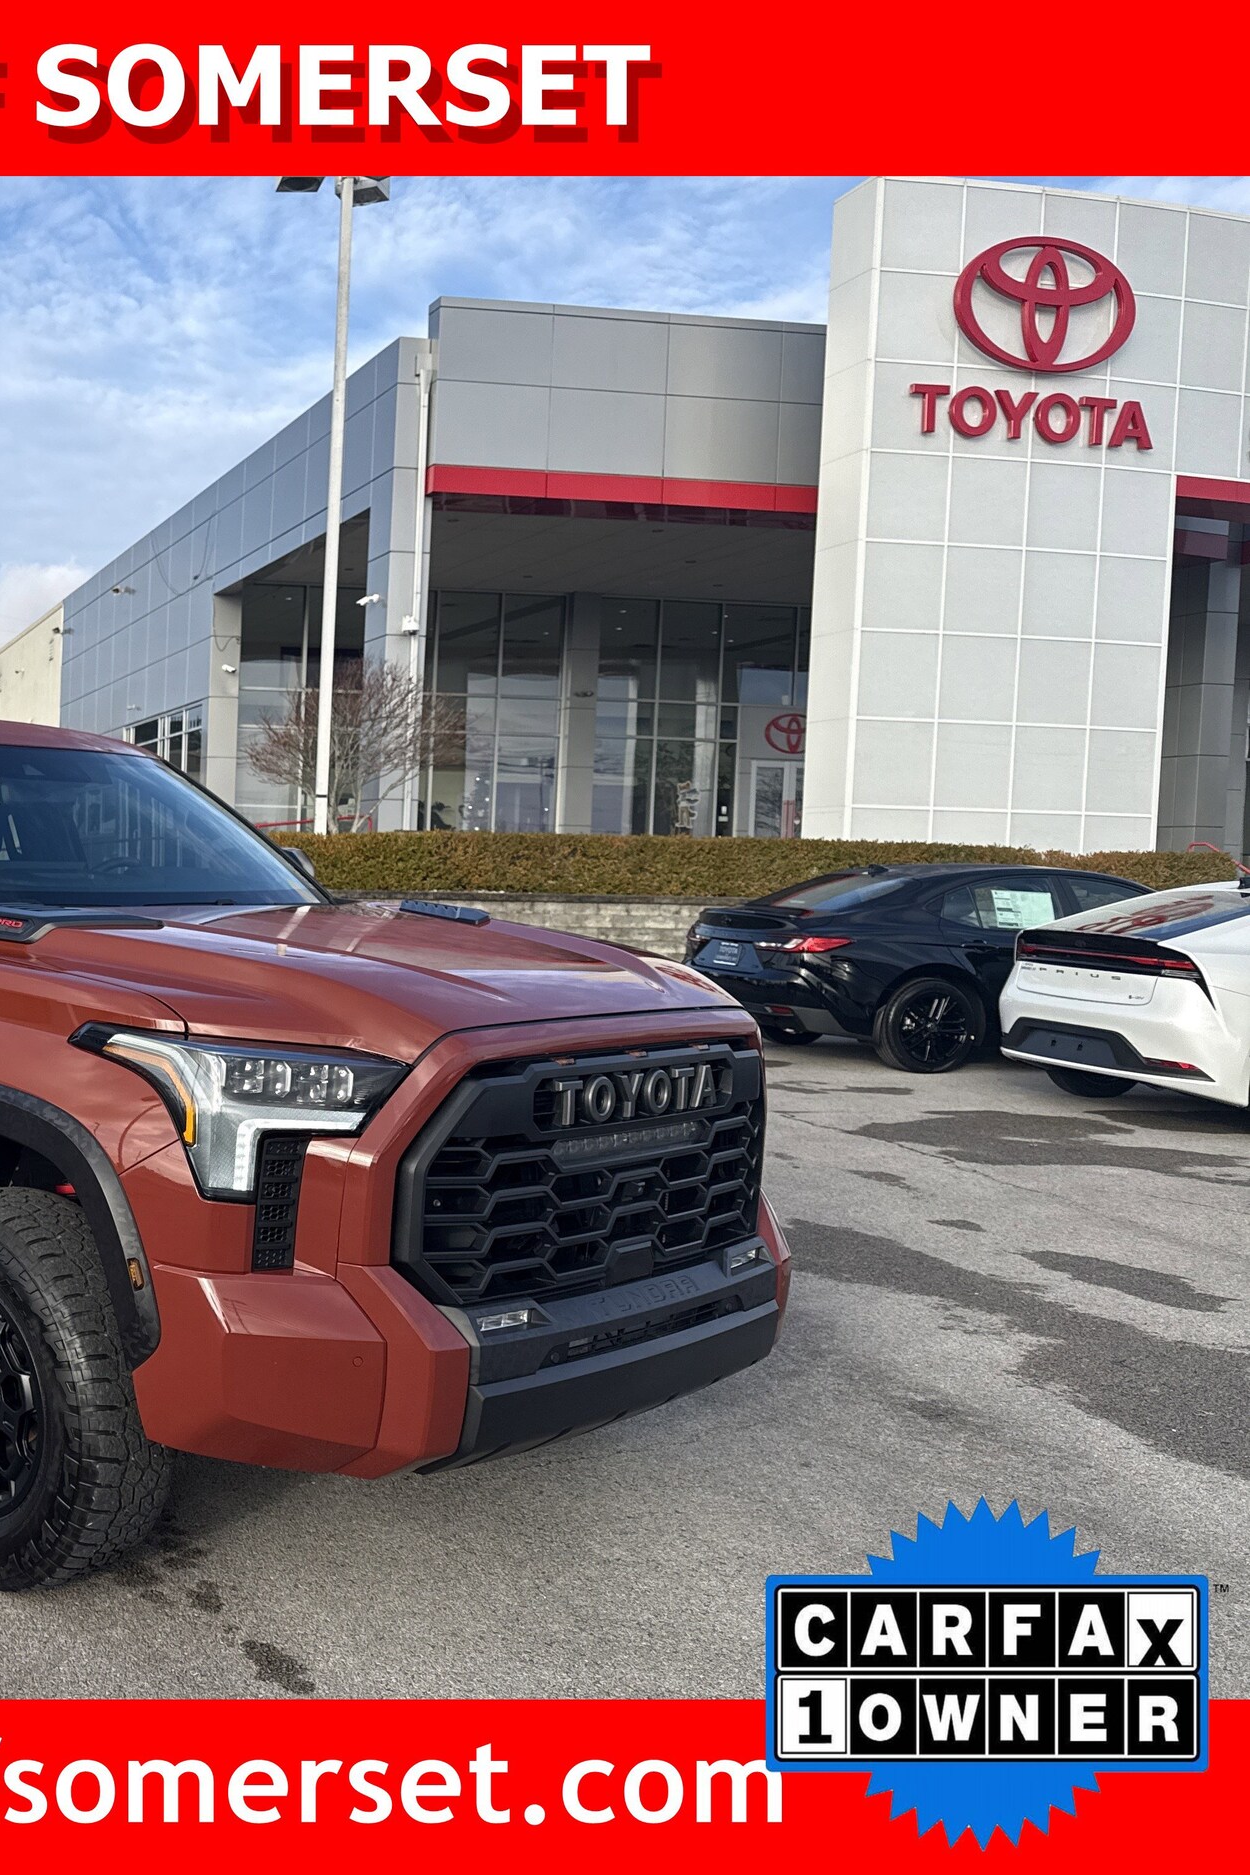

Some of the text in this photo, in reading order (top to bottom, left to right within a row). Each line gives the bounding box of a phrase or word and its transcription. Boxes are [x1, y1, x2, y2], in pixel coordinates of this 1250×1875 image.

[910, 383, 1153, 450] TOYOTA
[1039, 967, 1121, 981] PRIUS
[552, 1063, 718, 1128] TOYOTA
